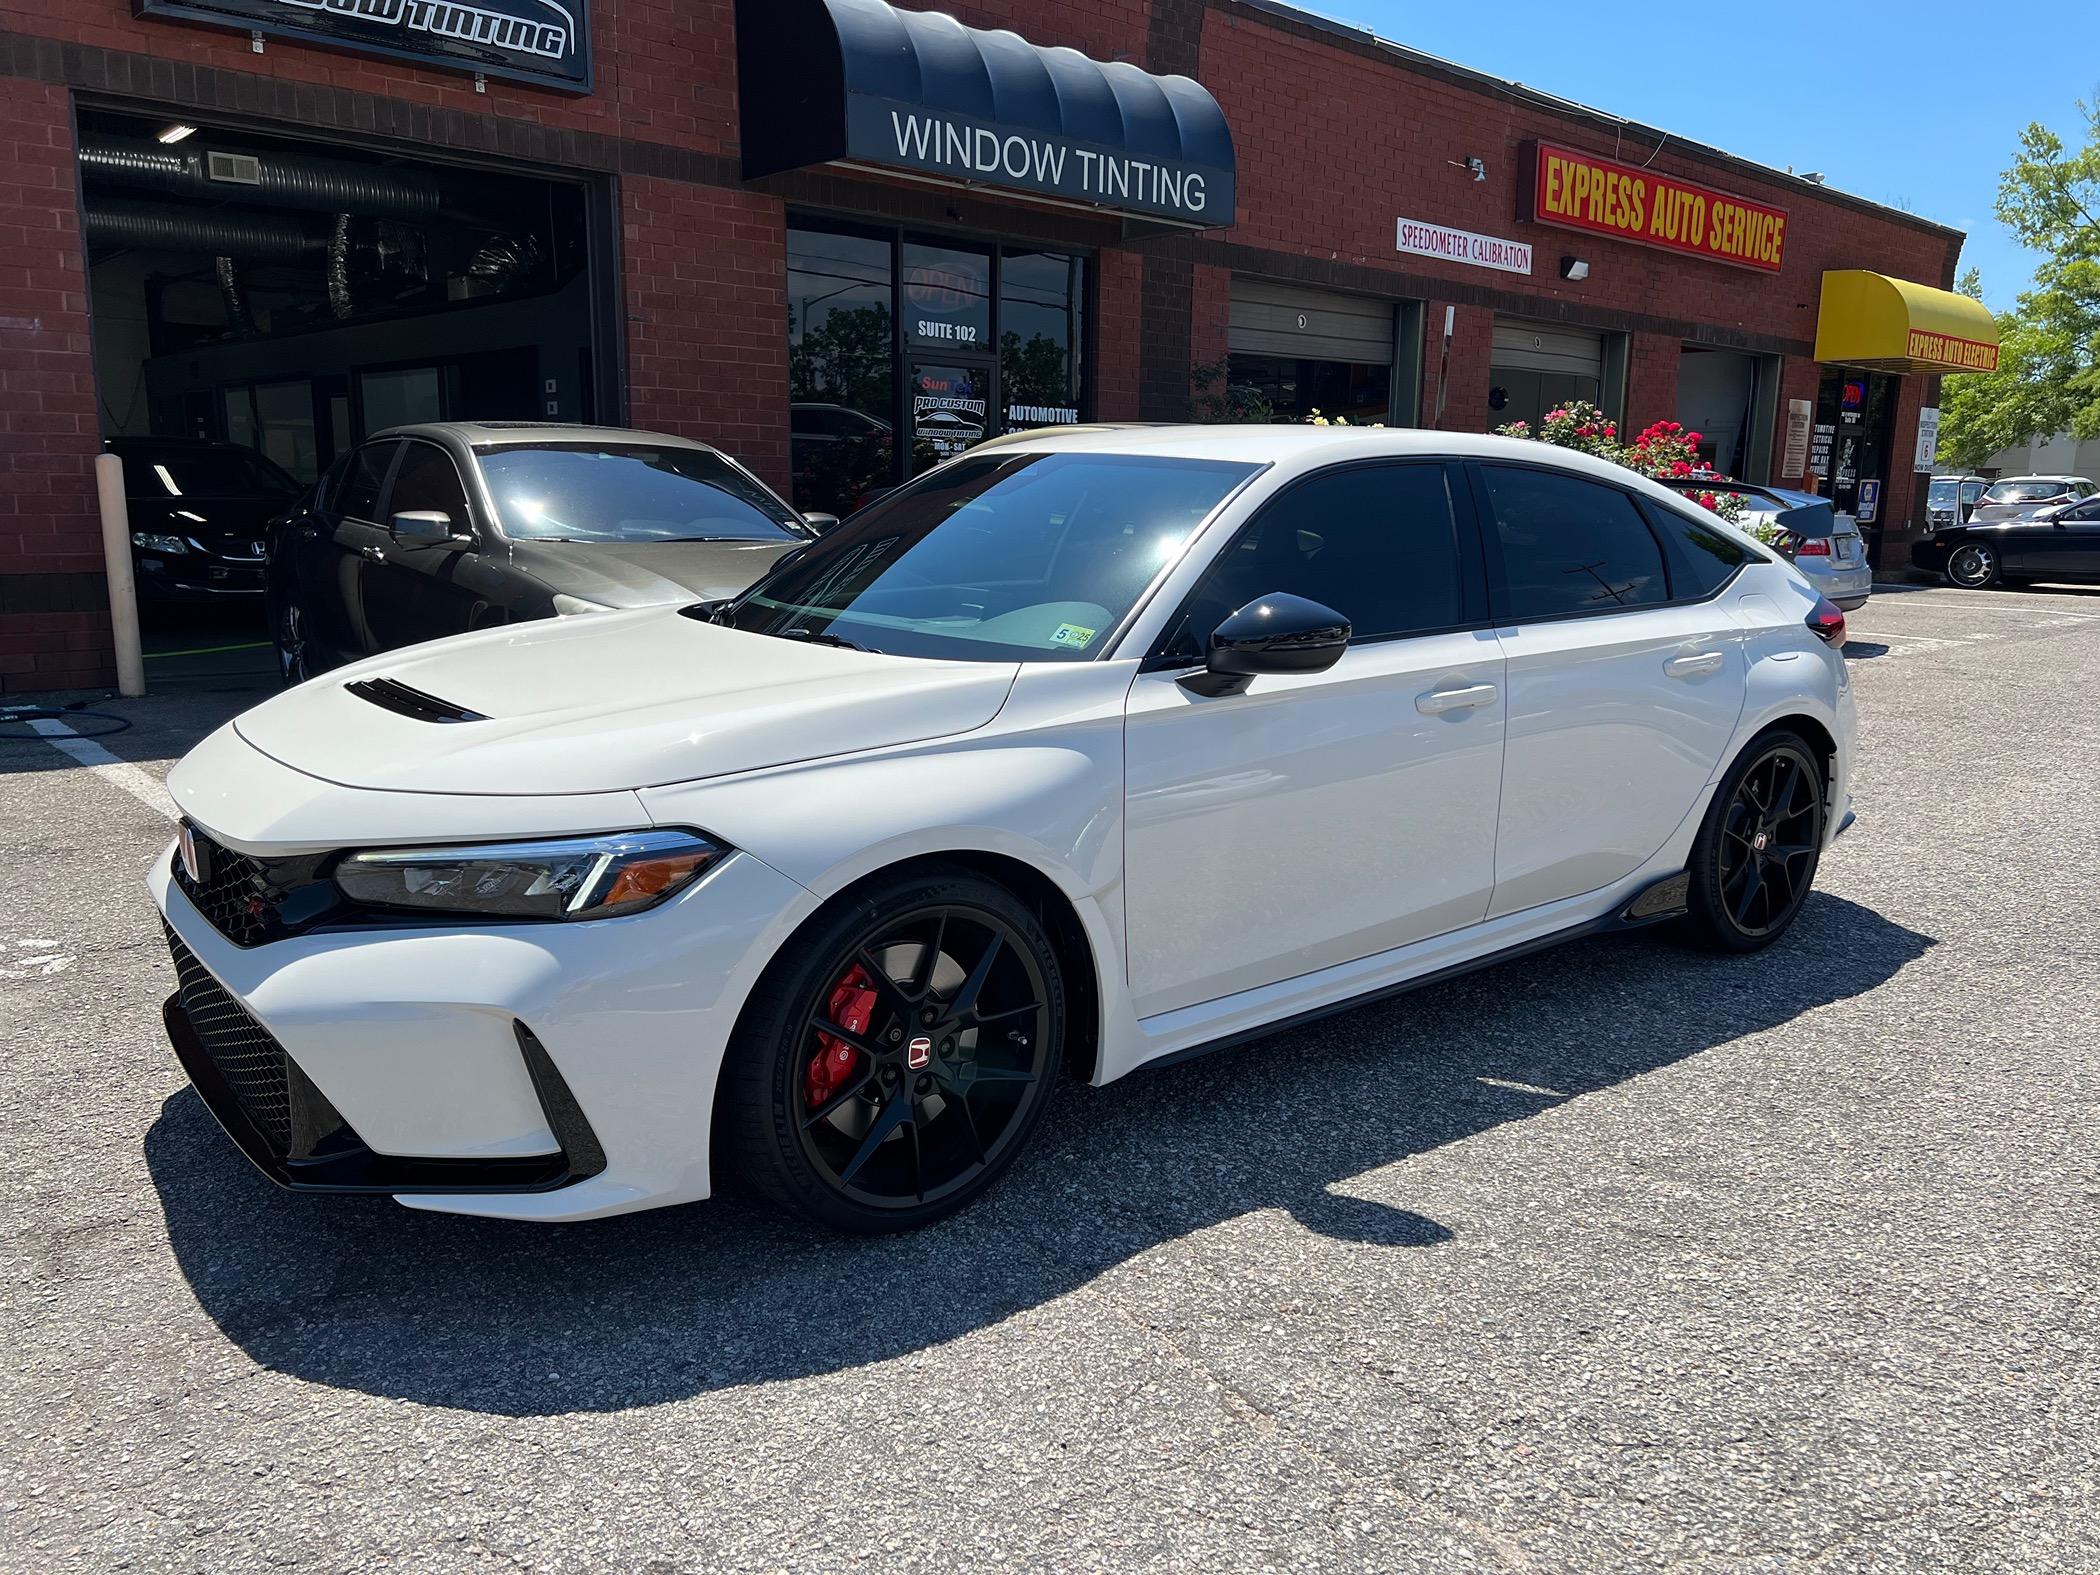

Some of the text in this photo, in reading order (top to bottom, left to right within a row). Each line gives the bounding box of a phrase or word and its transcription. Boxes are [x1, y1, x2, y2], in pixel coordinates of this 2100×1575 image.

[407, 0, 567, 59] TINTING
[892, 111, 1205, 211] WINDOW TINTING
[1545, 155, 1784, 264] EXPRESS AUTO SERVICE
[1401, 223, 1529, 269] SPEEDOMETER CALIBRATION
[908, 268, 975, 306] OPEN
[918, 320, 976, 342] SUITE 102
[1908, 332, 1996, 369] EXPRESS AUTO ELECTRIC
[914, 396, 985, 416] PRO CUSTOM
[1008, 404, 1078, 424] AUTOMOTIVE
[1056, 629, 1091, 641] 5 25
